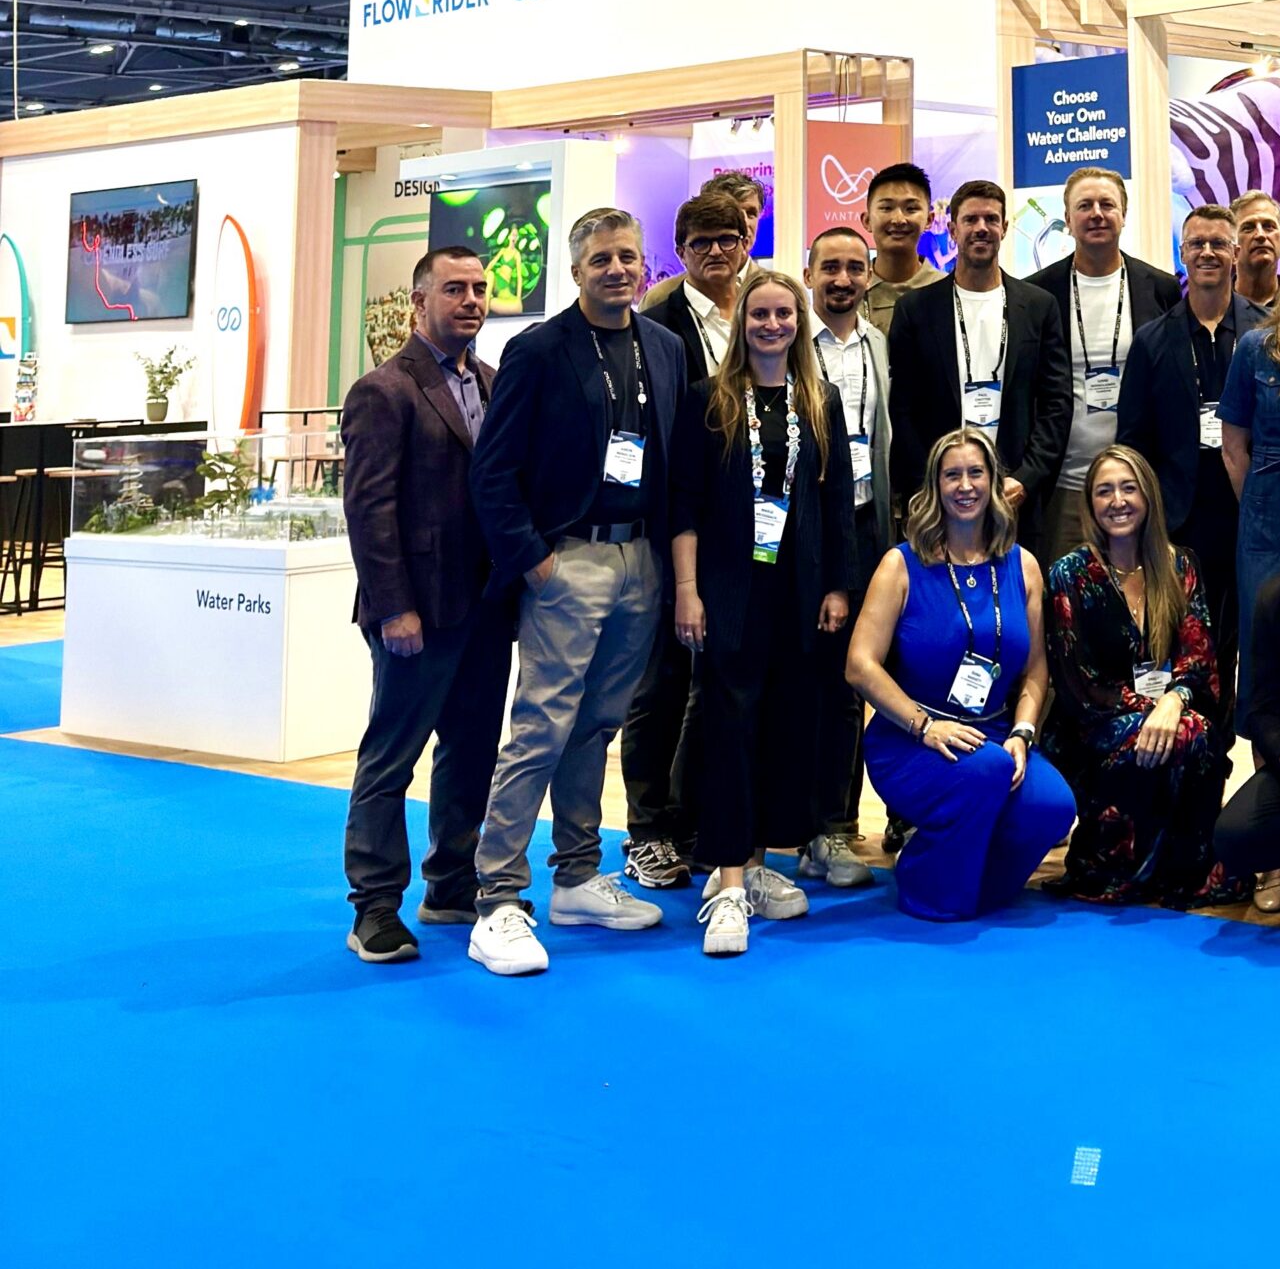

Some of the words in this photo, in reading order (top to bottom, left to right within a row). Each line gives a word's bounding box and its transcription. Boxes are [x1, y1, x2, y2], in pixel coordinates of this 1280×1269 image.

[1053, 90, 1099, 106] Choose
[1046, 111, 1074, 126] Your
[1076, 107, 1106, 123] Own
[1027, 132, 1064, 147] Water
[1066, 125, 1127, 143] Challenge
[1044, 148, 1109, 164] Adventure
[196, 589, 234, 611] Water
[237, 593, 271, 615] Parks
